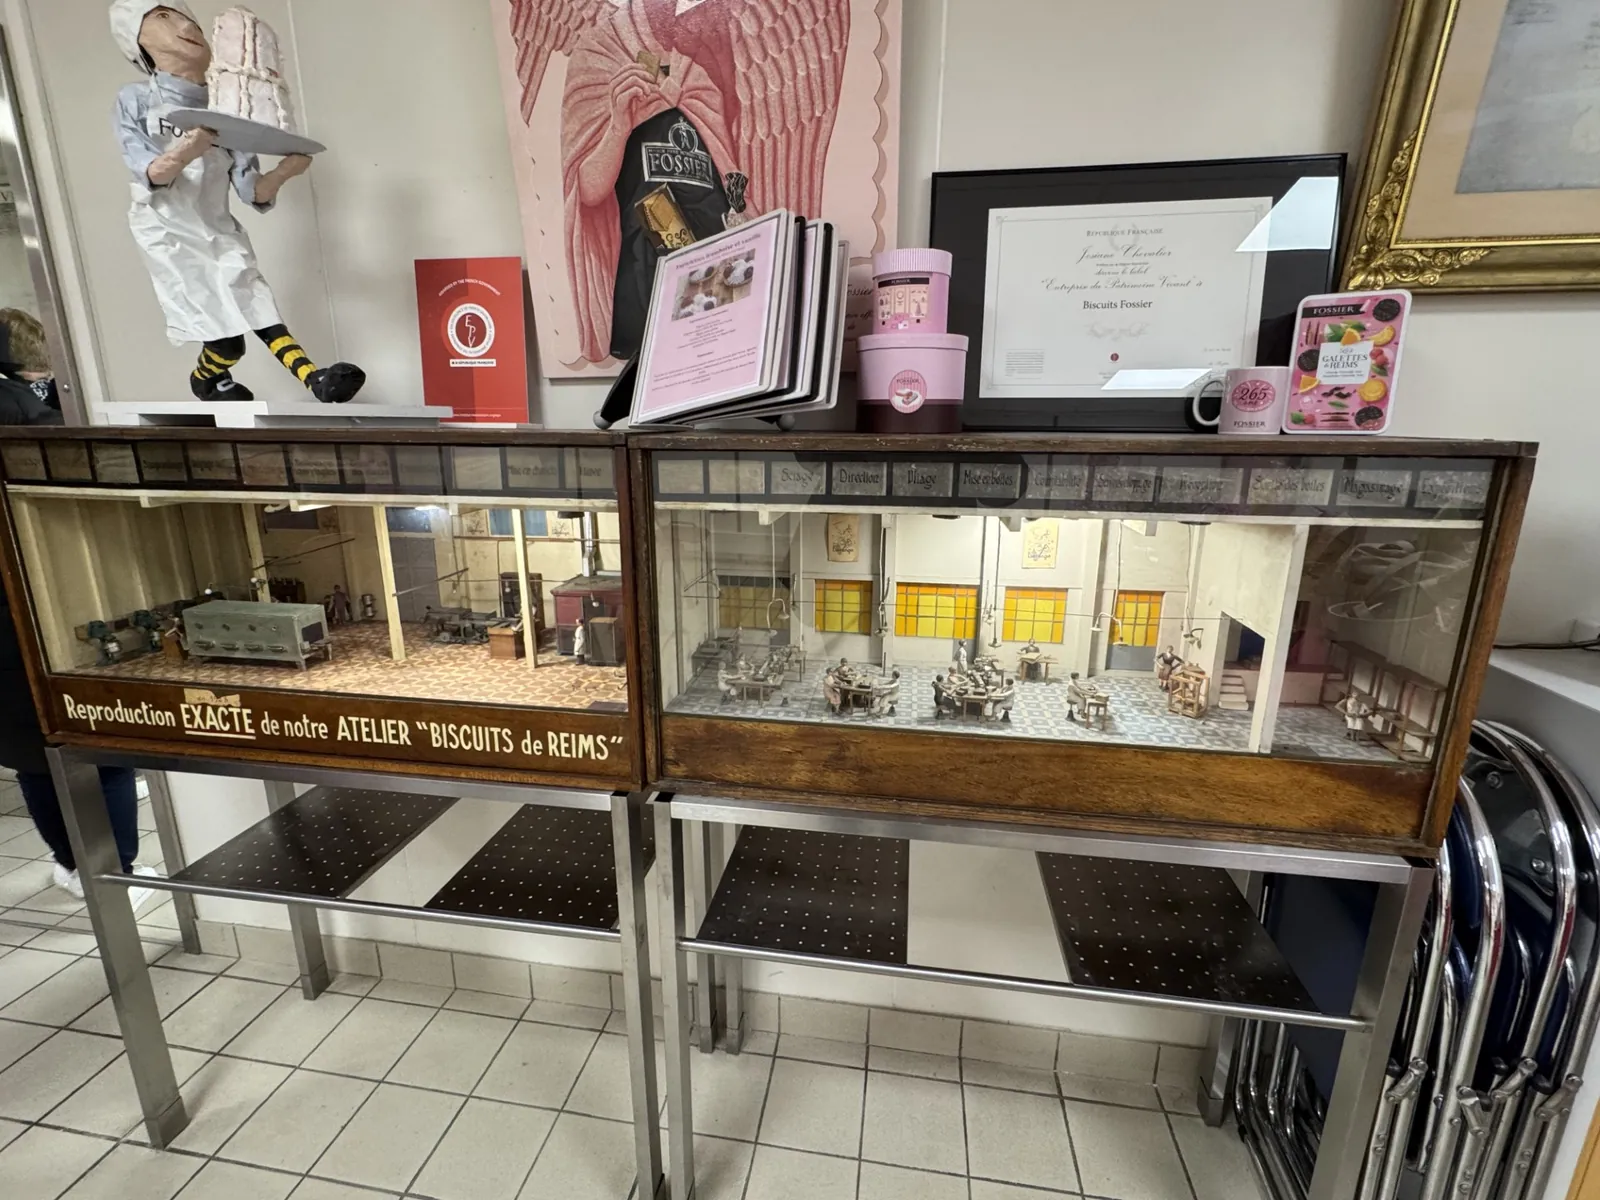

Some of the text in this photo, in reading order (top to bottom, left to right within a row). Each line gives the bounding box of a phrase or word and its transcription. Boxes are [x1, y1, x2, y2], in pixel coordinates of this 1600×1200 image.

[1082, 300, 1153, 310] Biscuits Fossier
[1313, 306, 1354, 315] FOSSIER
[1322, 354, 1368, 362] GALETTES
[1330, 361, 1358, 369] REIMS
[1239, 387, 1270, 401] 265
[1233, 420, 1266, 428] FOSSIER
[839, 468, 880, 485] Direction
[62, 693, 176, 731] Reproduction
[180, 703, 256, 735] EXACTE
[260, 712, 280, 736] de
[284, 714, 329, 740] notre
[336, 715, 412, 746] ATELIER
[521, 730, 544, 756] de
